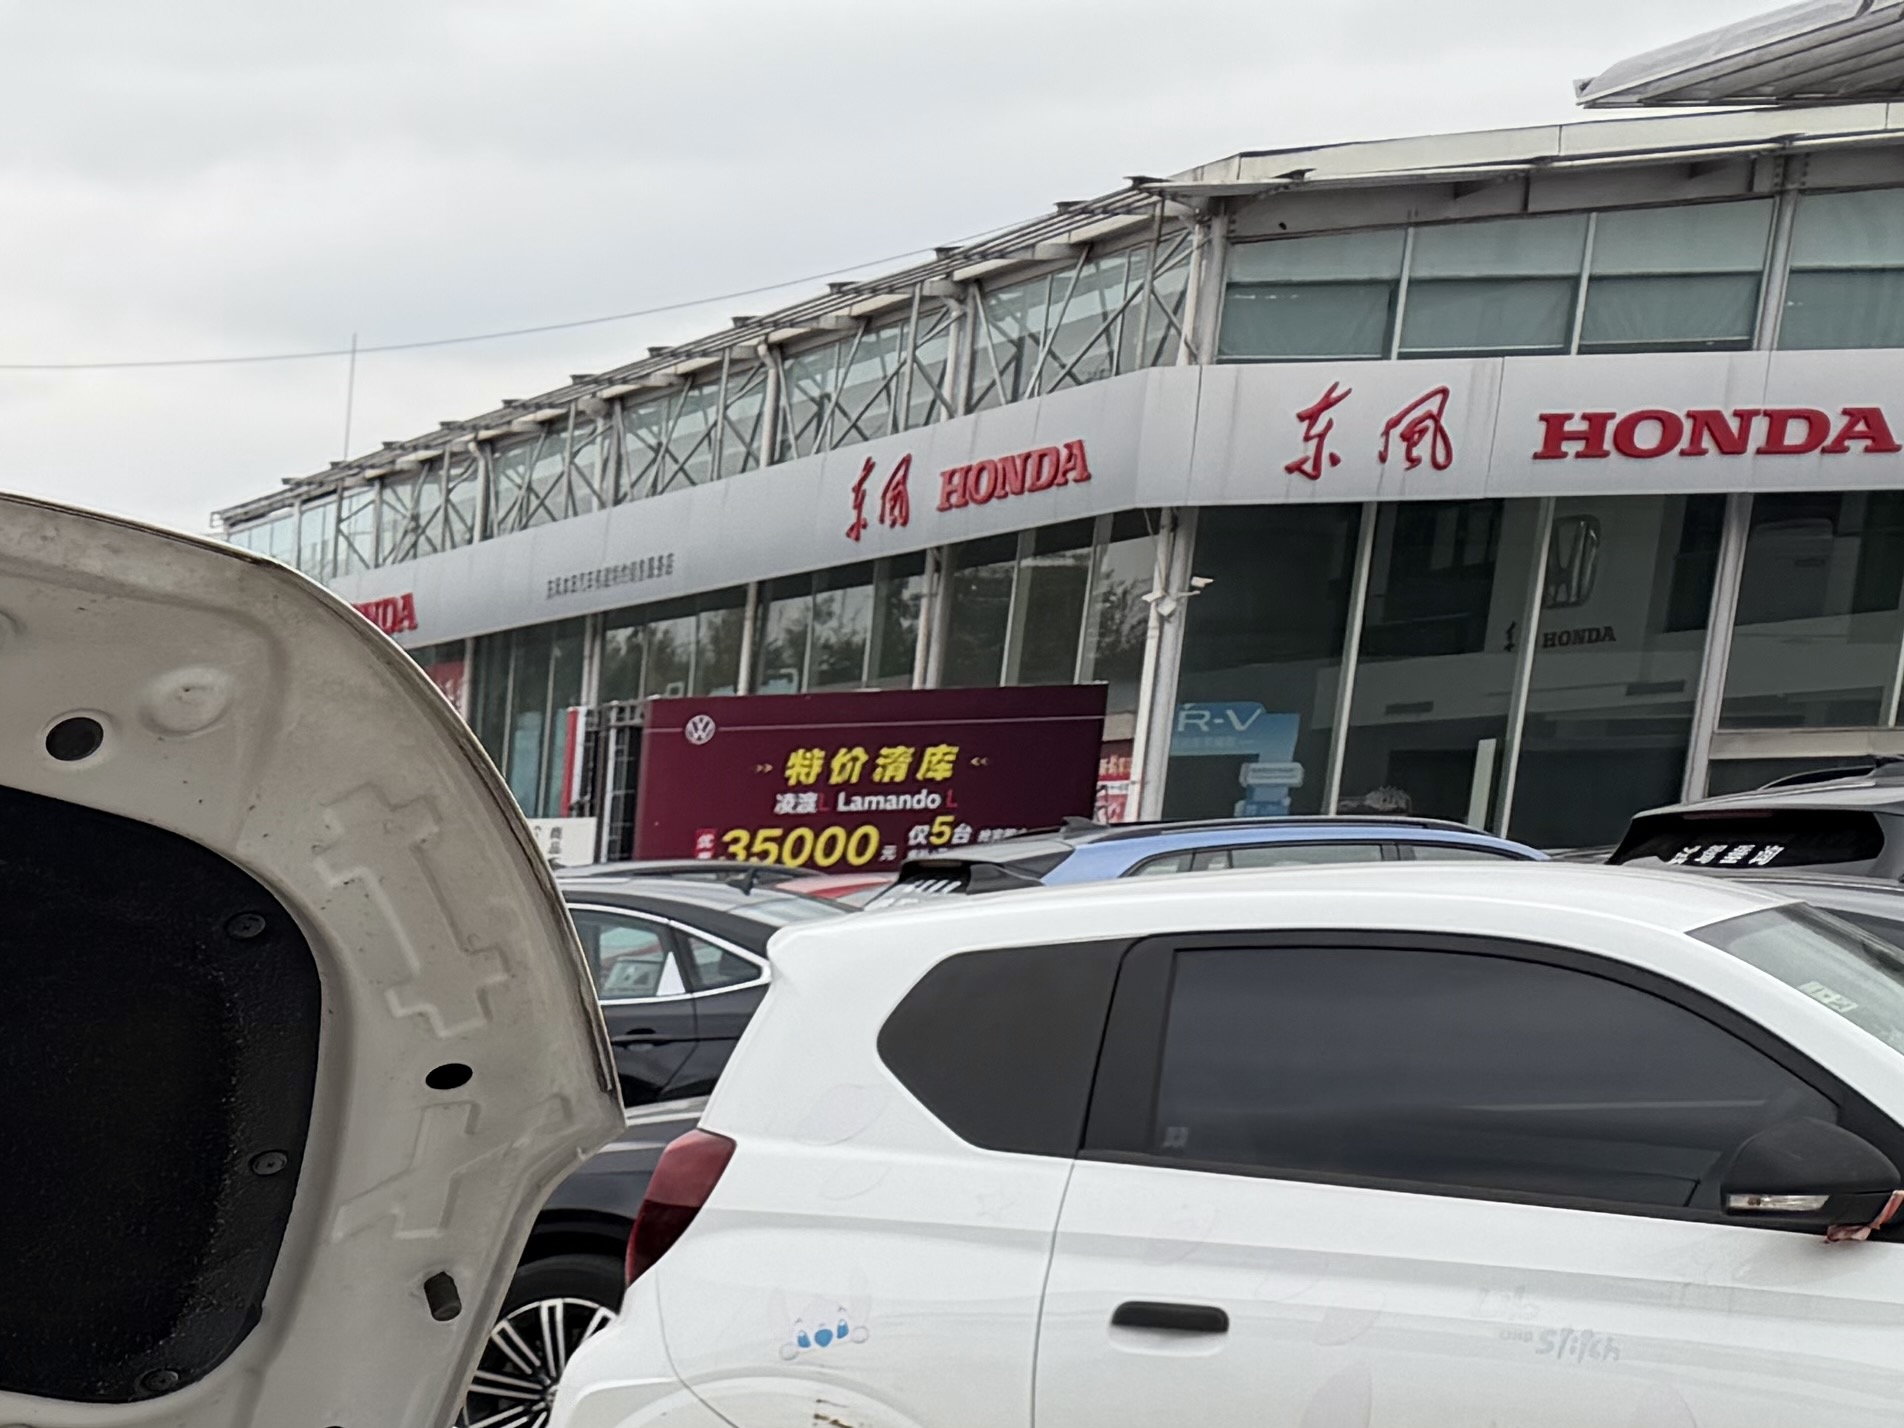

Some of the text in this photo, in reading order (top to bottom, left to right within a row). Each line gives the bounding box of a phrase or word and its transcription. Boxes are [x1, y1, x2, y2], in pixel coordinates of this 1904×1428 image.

[1532, 406, 1903, 461] HONDA
[936, 439, 1092, 512] HONDA
[352, 592, 419, 633] NDA
[1542, 626, 1616, 648] HONDA
[1177, 707, 1262, 732] R-V
[783, 744, 960, 786] 特价清库
[837, 789, 941, 813] Lamando
[721, 825, 880, 868] 35000
